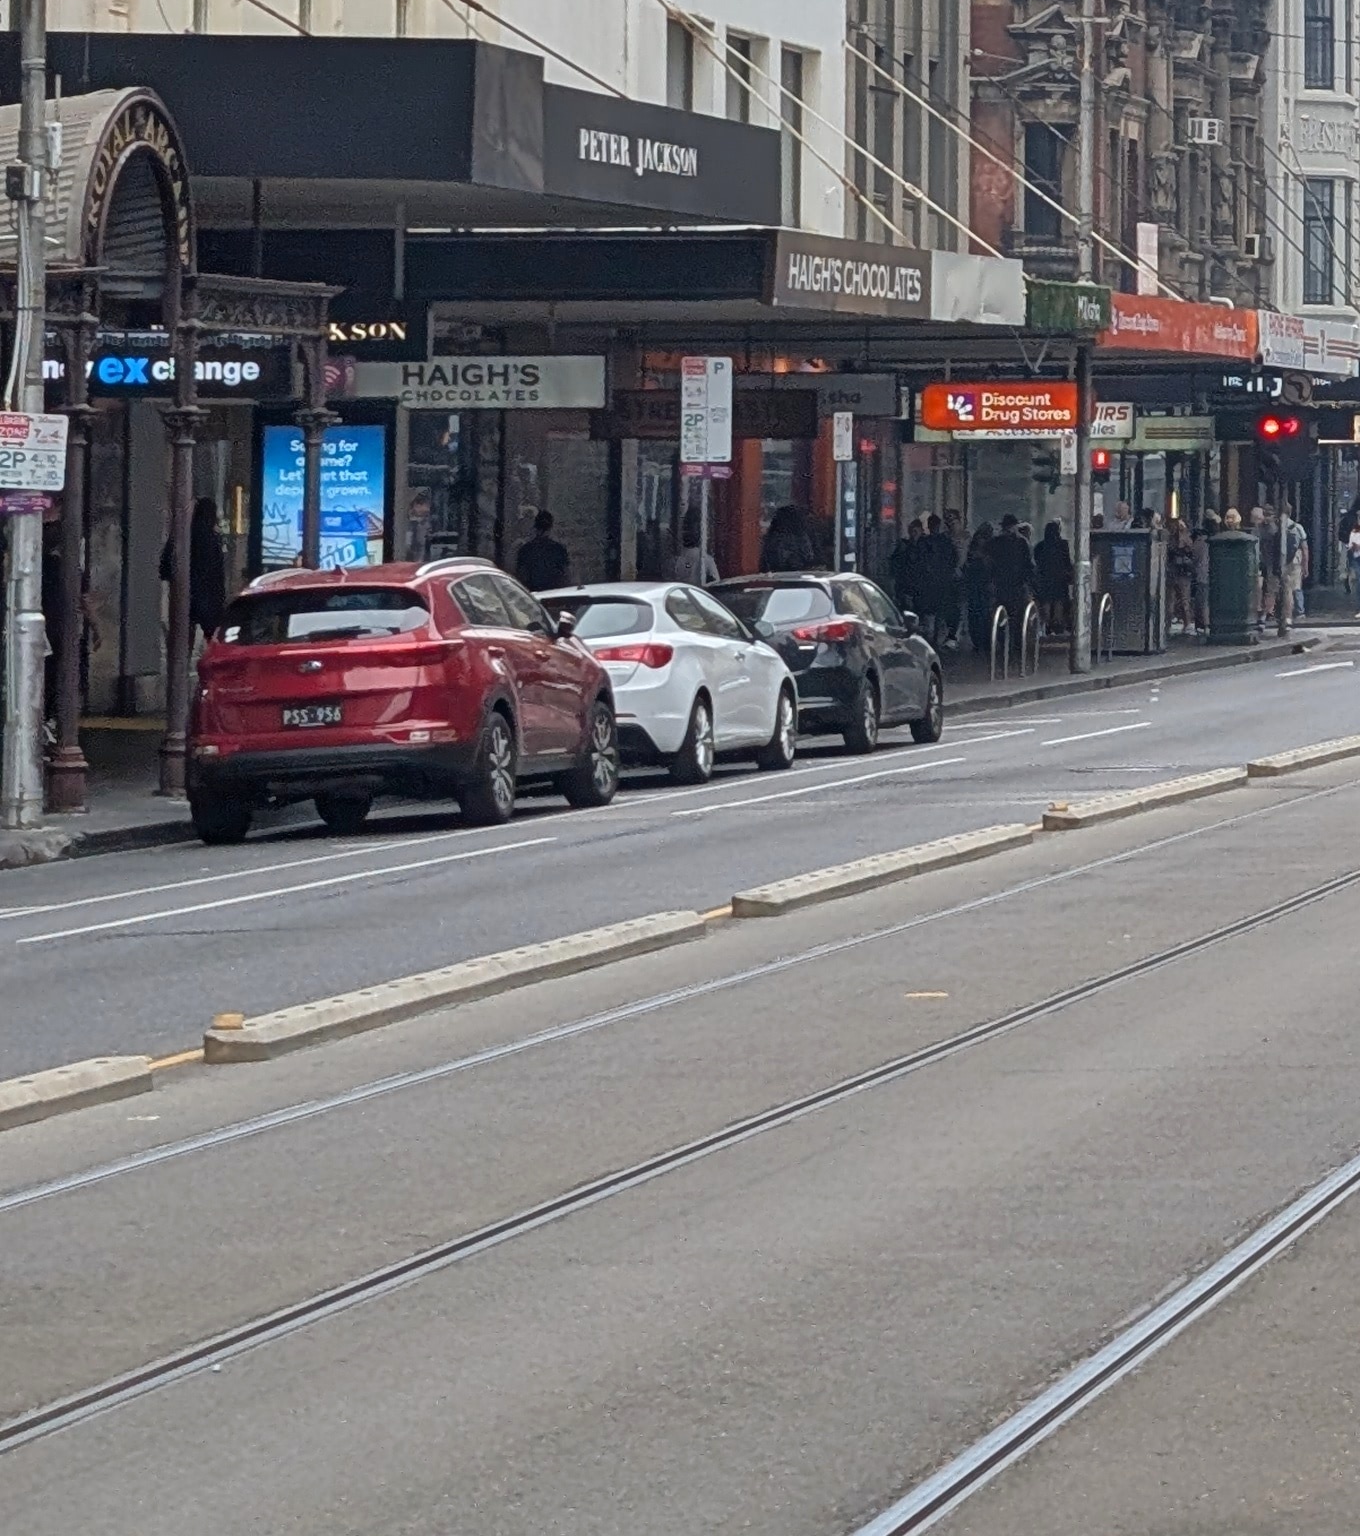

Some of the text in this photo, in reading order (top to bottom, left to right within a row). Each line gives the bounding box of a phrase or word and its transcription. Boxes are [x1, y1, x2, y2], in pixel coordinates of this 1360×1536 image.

[579, 128, 698, 177] PETER JACKSON
[788, 253, 921, 302] HAIGH'S CHOCOLATES
[402, 364, 540, 386] HAIGH'S
[402, 389, 540, 402] CHOCOLATES
[982, 392, 1051, 406] Discount
[685, 413, 704, 427] 2P
[982, 407, 1071, 424] Drug Stores
